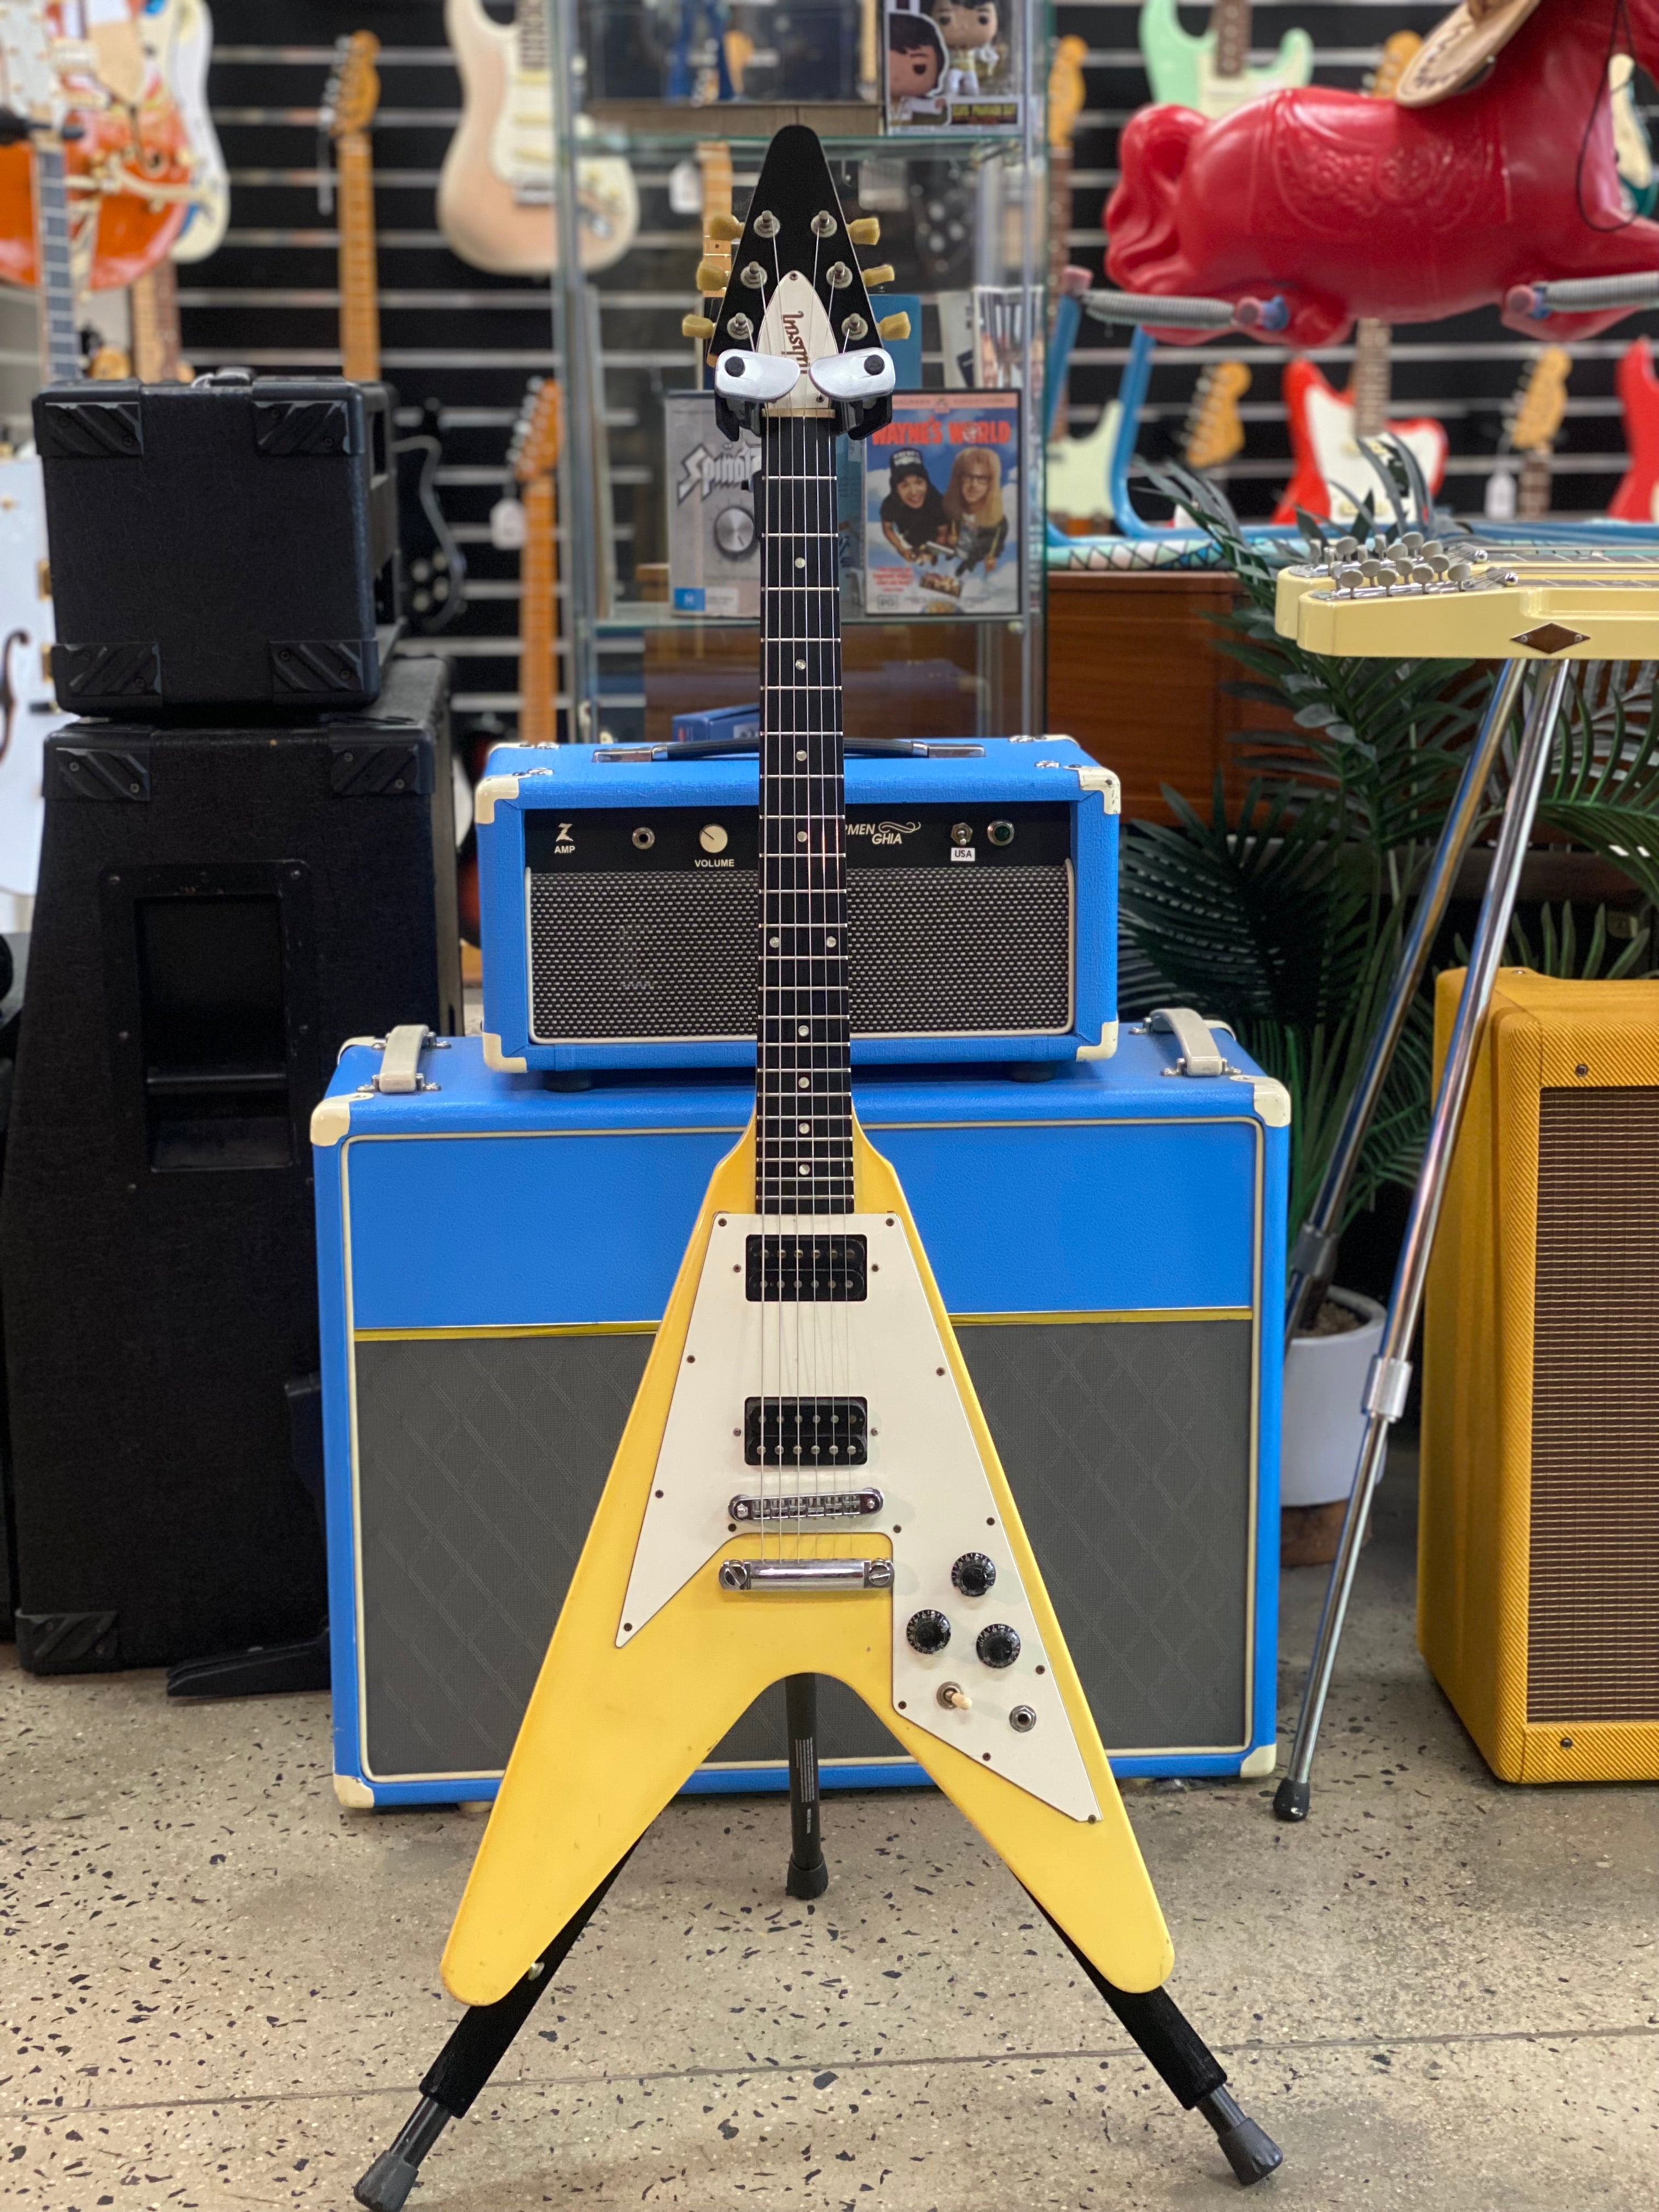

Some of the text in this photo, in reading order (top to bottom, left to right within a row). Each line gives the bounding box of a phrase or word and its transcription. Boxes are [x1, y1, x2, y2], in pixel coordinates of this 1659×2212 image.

[781, 311, 810, 374] ibson
[872, 415, 1012, 445] WAYNE'S WORLD
[845, 823, 876, 835] MEN
[872, 833, 902, 844] GHIA
[554, 845, 575, 854] AMP
[955, 850, 972, 858] USA
[695, 859, 735, 867] VOLUME
